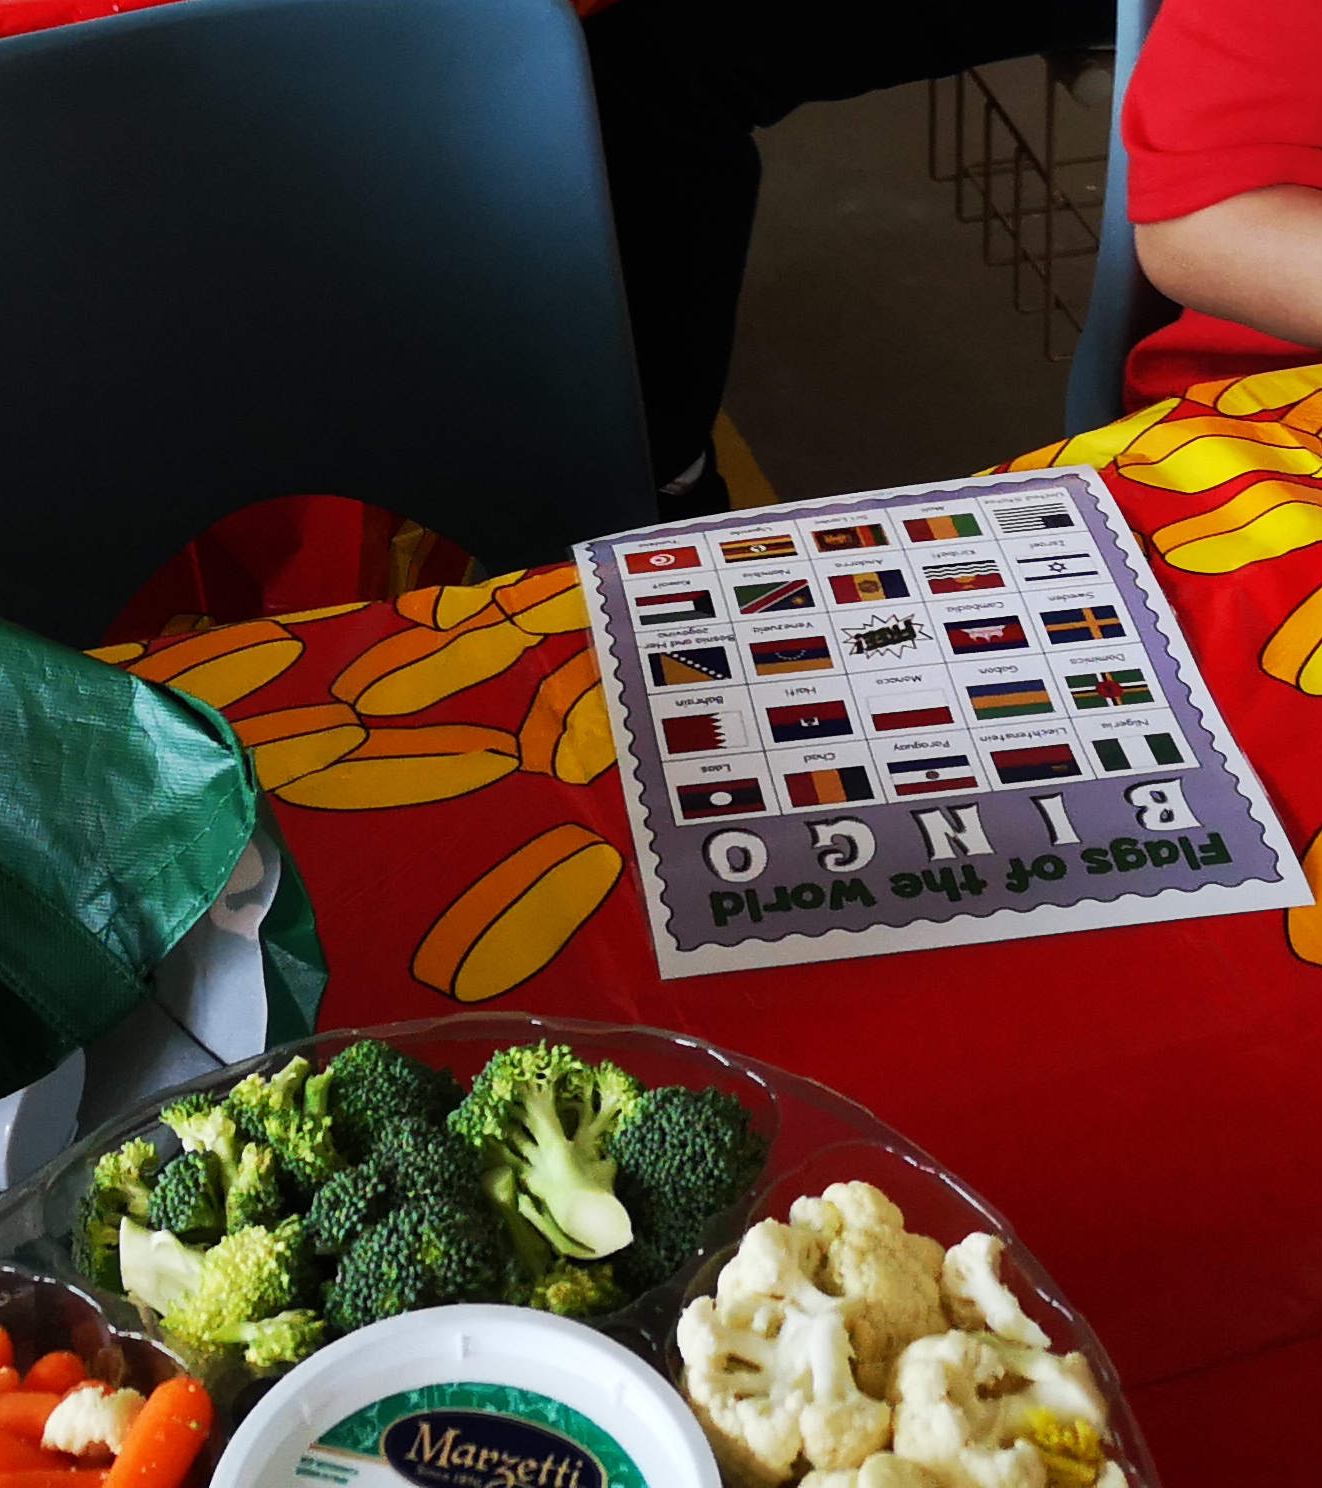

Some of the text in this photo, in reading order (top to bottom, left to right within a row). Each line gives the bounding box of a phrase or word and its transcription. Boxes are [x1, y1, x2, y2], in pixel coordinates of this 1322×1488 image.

[1030, 540, 1067, 550] Israel
[834, 558, 884, 569] Andorra
[1047, 591, 1095, 602] Sweden
[946, 601, 1004, 614] Cambodia
[753, 622, 814, 634] Venezuela
[672, 638, 692, 647] and
[696, 634, 736, 645] Bosnia
[854, 618, 917, 655] FREE!
[1069, 653, 1126, 665] Dominica
[978, 665, 1019, 675] Gabon
[876, 675, 923, 686] Monaco
[785, 685, 817, 696] Haiti
[674, 695, 724, 708] Bahrain
[1100, 718, 1149, 730] Nigeria
[978, 727, 1067, 742] Liechtenstein
[893, 739, 952, 754] Paraguay
[803, 752, 836, 764] Chad
[700, 762, 732, 774] Laos
[709, 831, 1234, 928] Flags of the World
[404, 1419, 585, 1488] Marzetti
